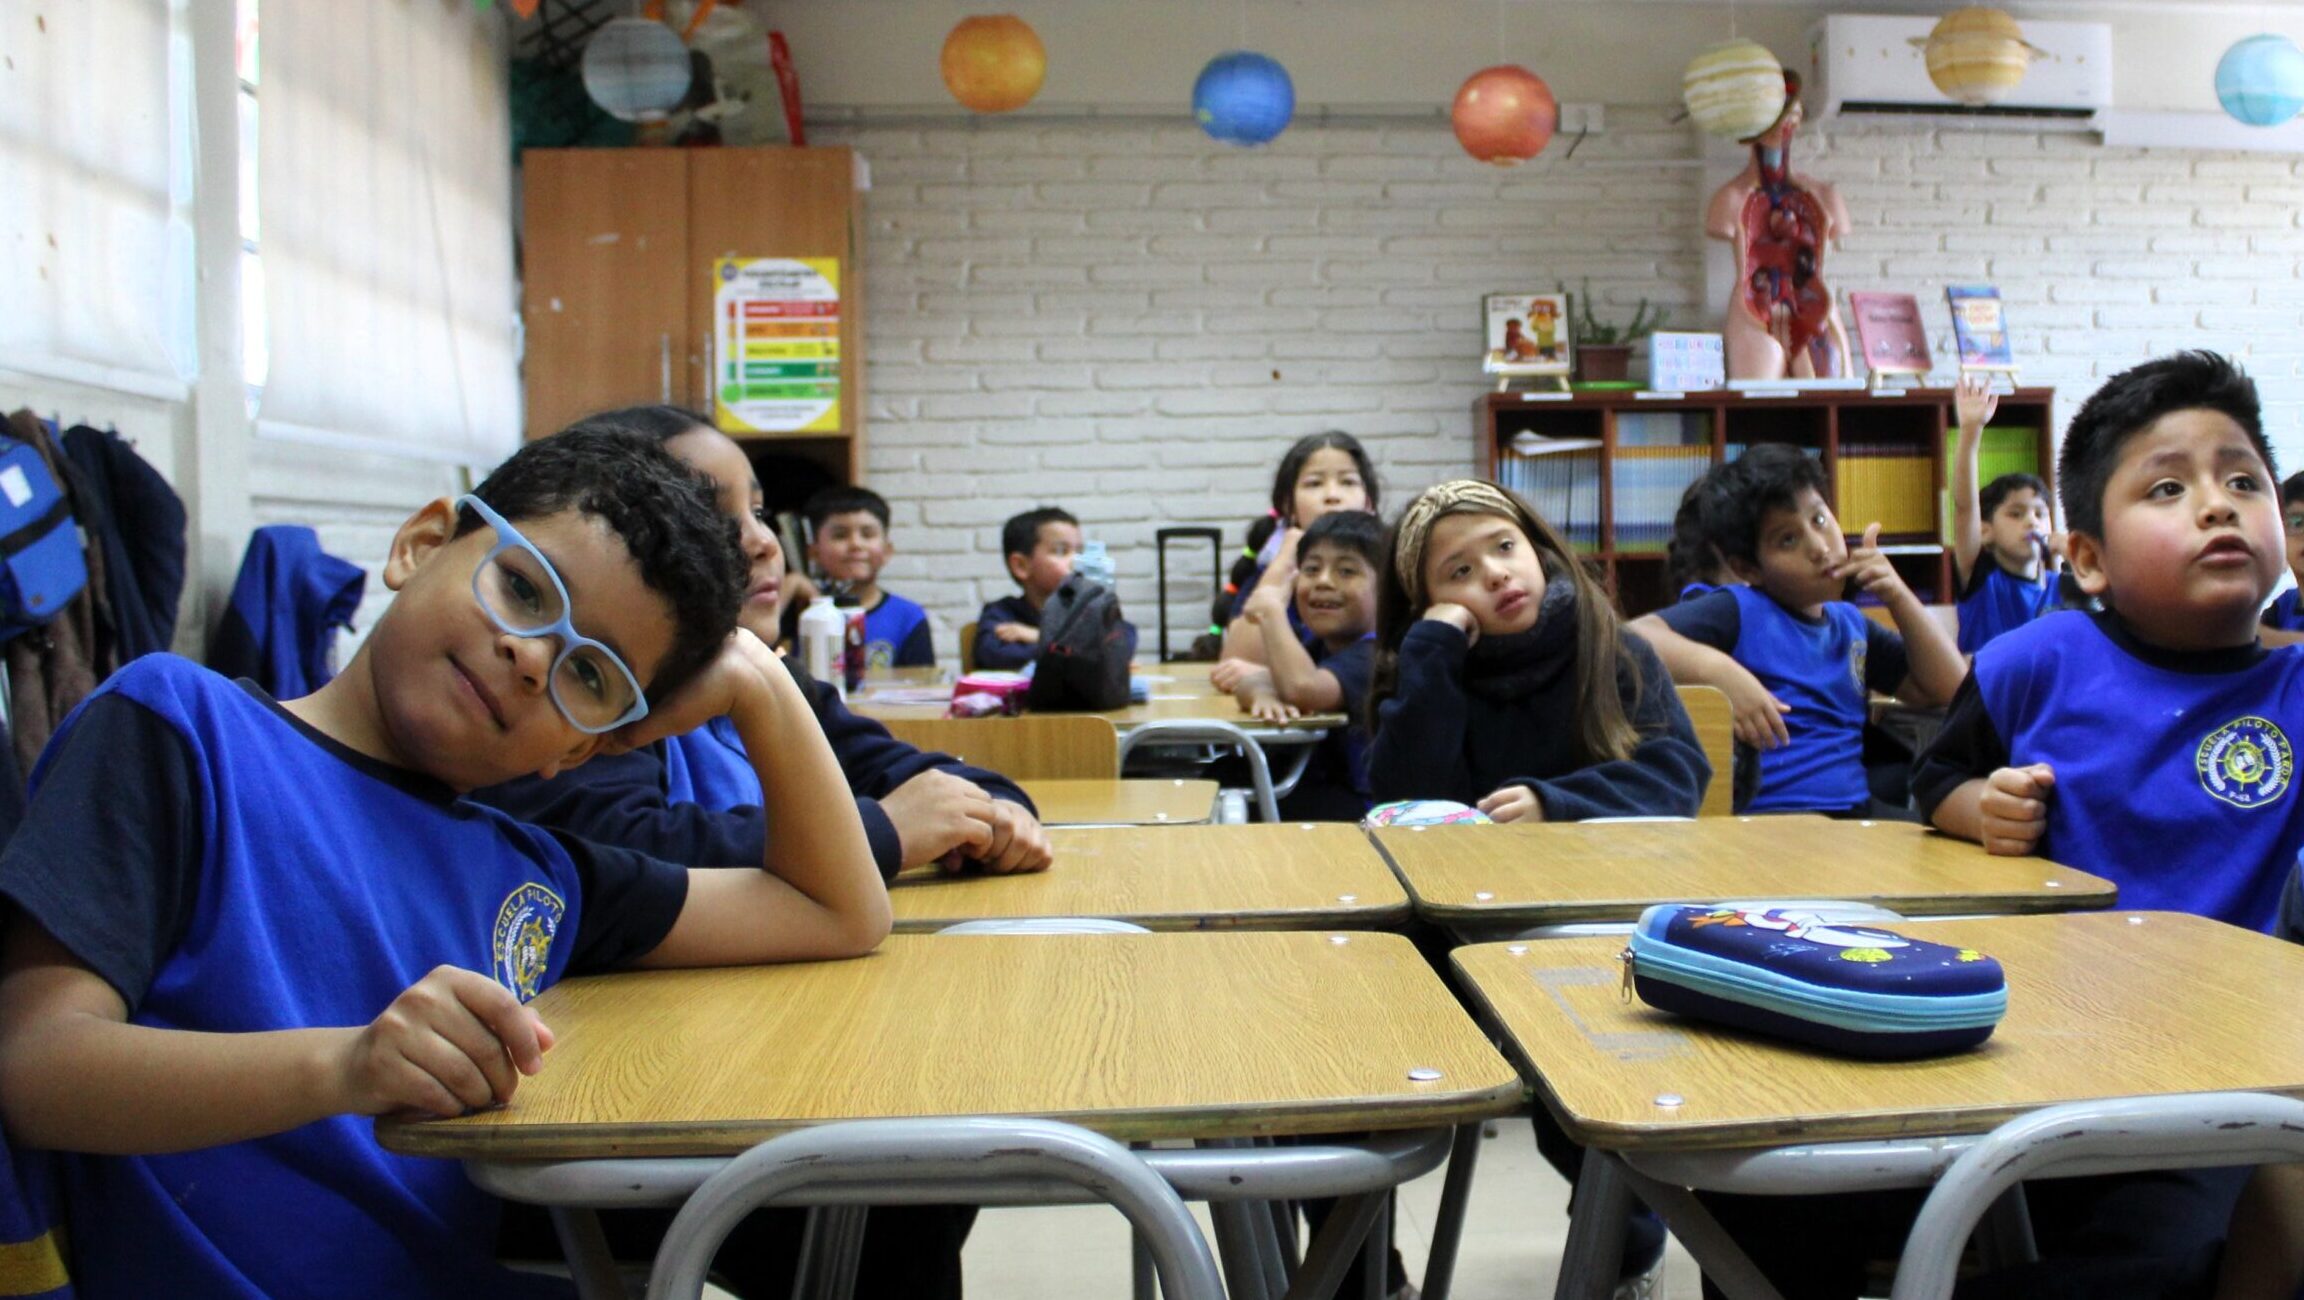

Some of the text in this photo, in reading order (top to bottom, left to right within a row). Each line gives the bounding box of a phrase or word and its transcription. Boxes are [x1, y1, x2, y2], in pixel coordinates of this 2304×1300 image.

[2199, 727, 2230, 772] ESCUELA
[2232, 720, 2279, 738] PILOTO
[496, 889, 562, 961] ESCUELA PILOTO
